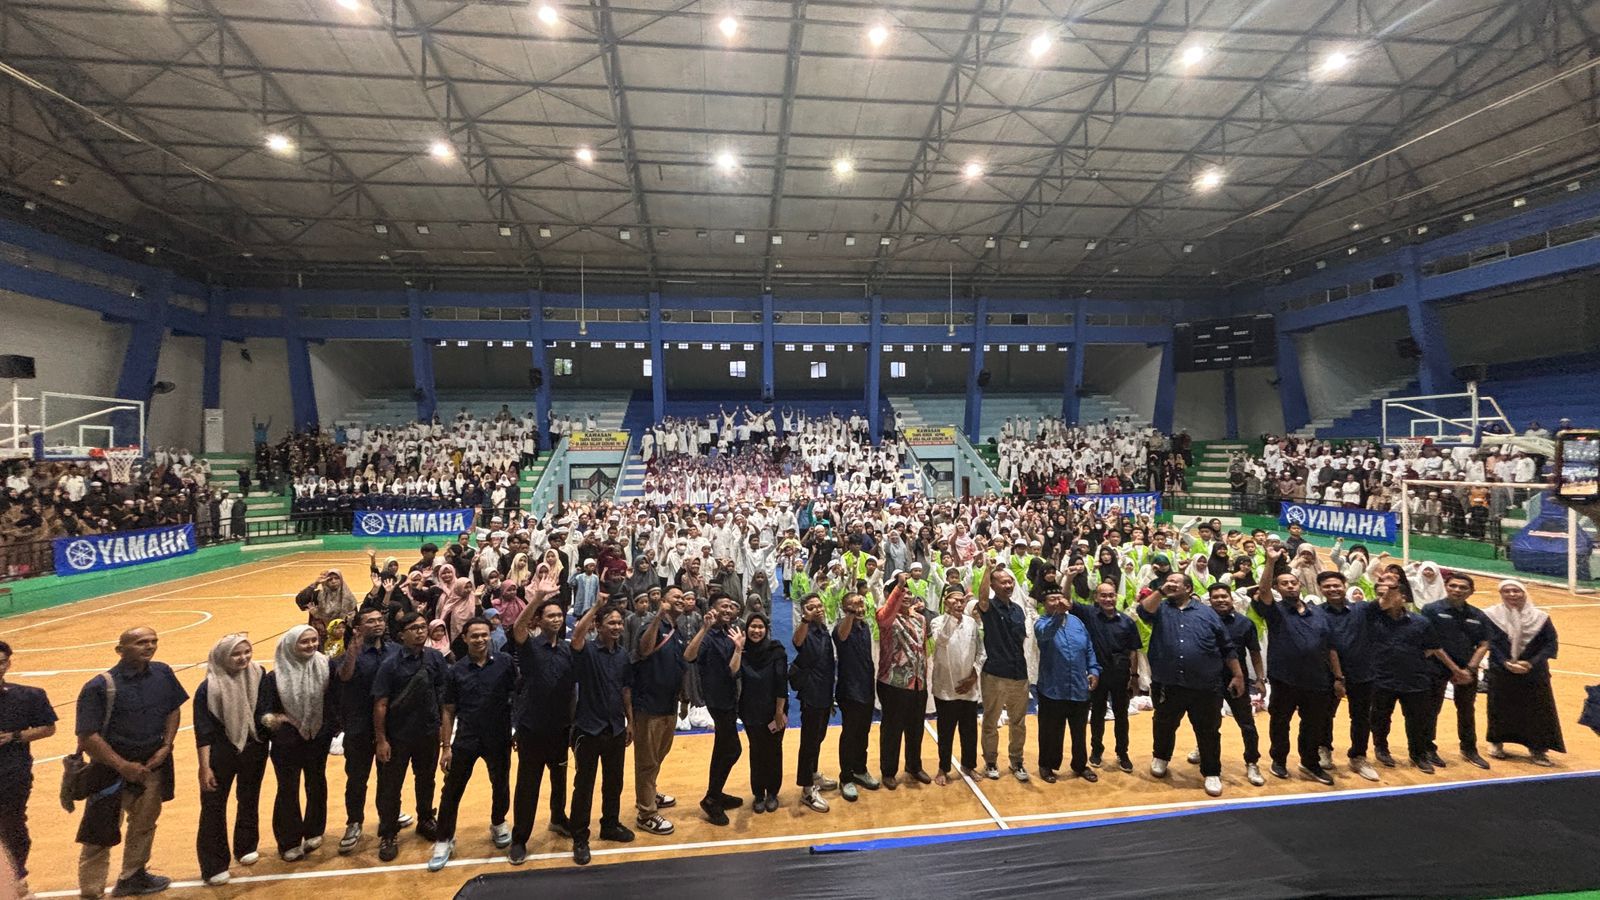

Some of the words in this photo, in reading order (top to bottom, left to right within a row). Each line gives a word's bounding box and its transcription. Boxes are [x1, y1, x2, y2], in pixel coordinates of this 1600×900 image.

[385, 512, 465, 533] YAMAHA
[1307, 508, 1387, 537] YAMAHA
[98, 528, 190, 565] YAMAHA
